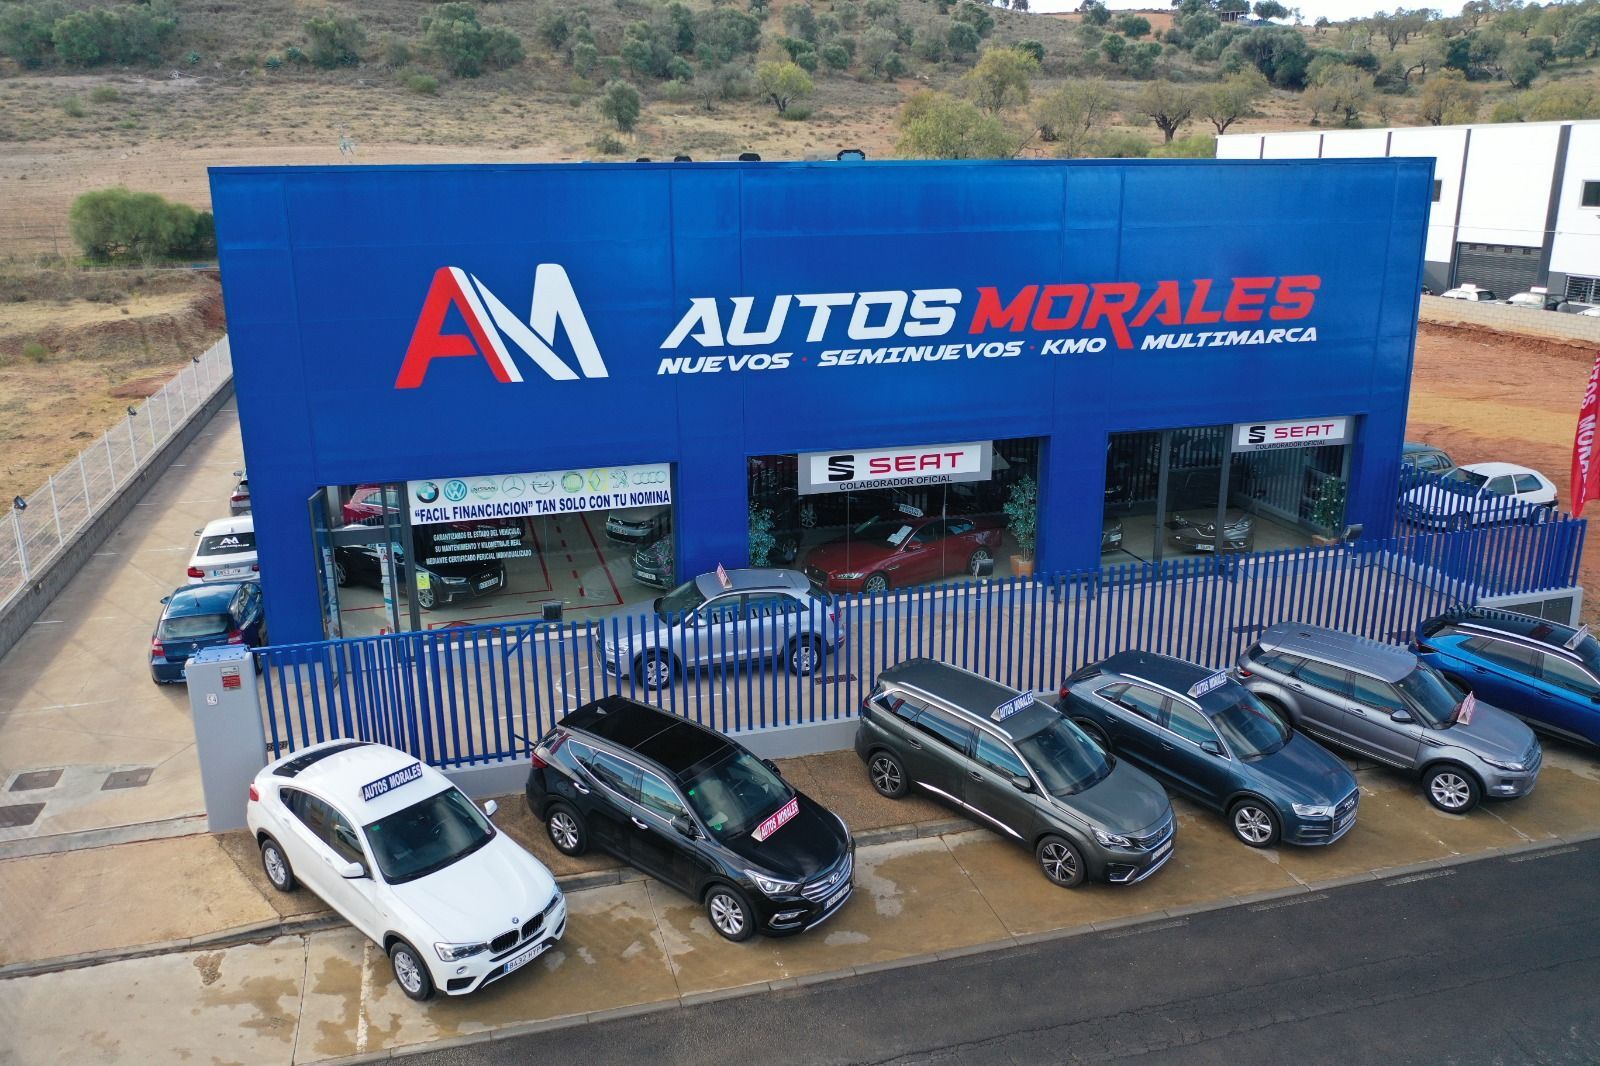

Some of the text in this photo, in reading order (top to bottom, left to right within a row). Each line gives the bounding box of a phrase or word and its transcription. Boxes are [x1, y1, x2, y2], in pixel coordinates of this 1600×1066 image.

[659, 274, 1322, 350] AUTOS MORALES
[395, 263, 609, 389] AM
[657, 352, 793, 375] NUEVOS
[817, 341, 1025, 367] SEMINUEVOS
[1141, 327, 1317, 350] MULTIMARCA
[1274, 424, 1335, 438] SEAT
[1256, 441, 1302, 450] COLABORADOR
[869, 452, 964, 474] SEAT
[839, 474, 953, 491] COLABORADOR OFICIAL
[536, 499, 556, 513] TAN
[560, 497, 586, 511] SOLO
[589, 495, 610, 508] CON
[613, 494, 627, 507] TU
[630, 490, 670, 506] NOMINA
[467, 531, 473, 539] EL
[473, 530, 489, 538] ESTADO
[364, 764, 422, 800] AUTOS MORALES
[761, 817, 776, 837] AUTOS
